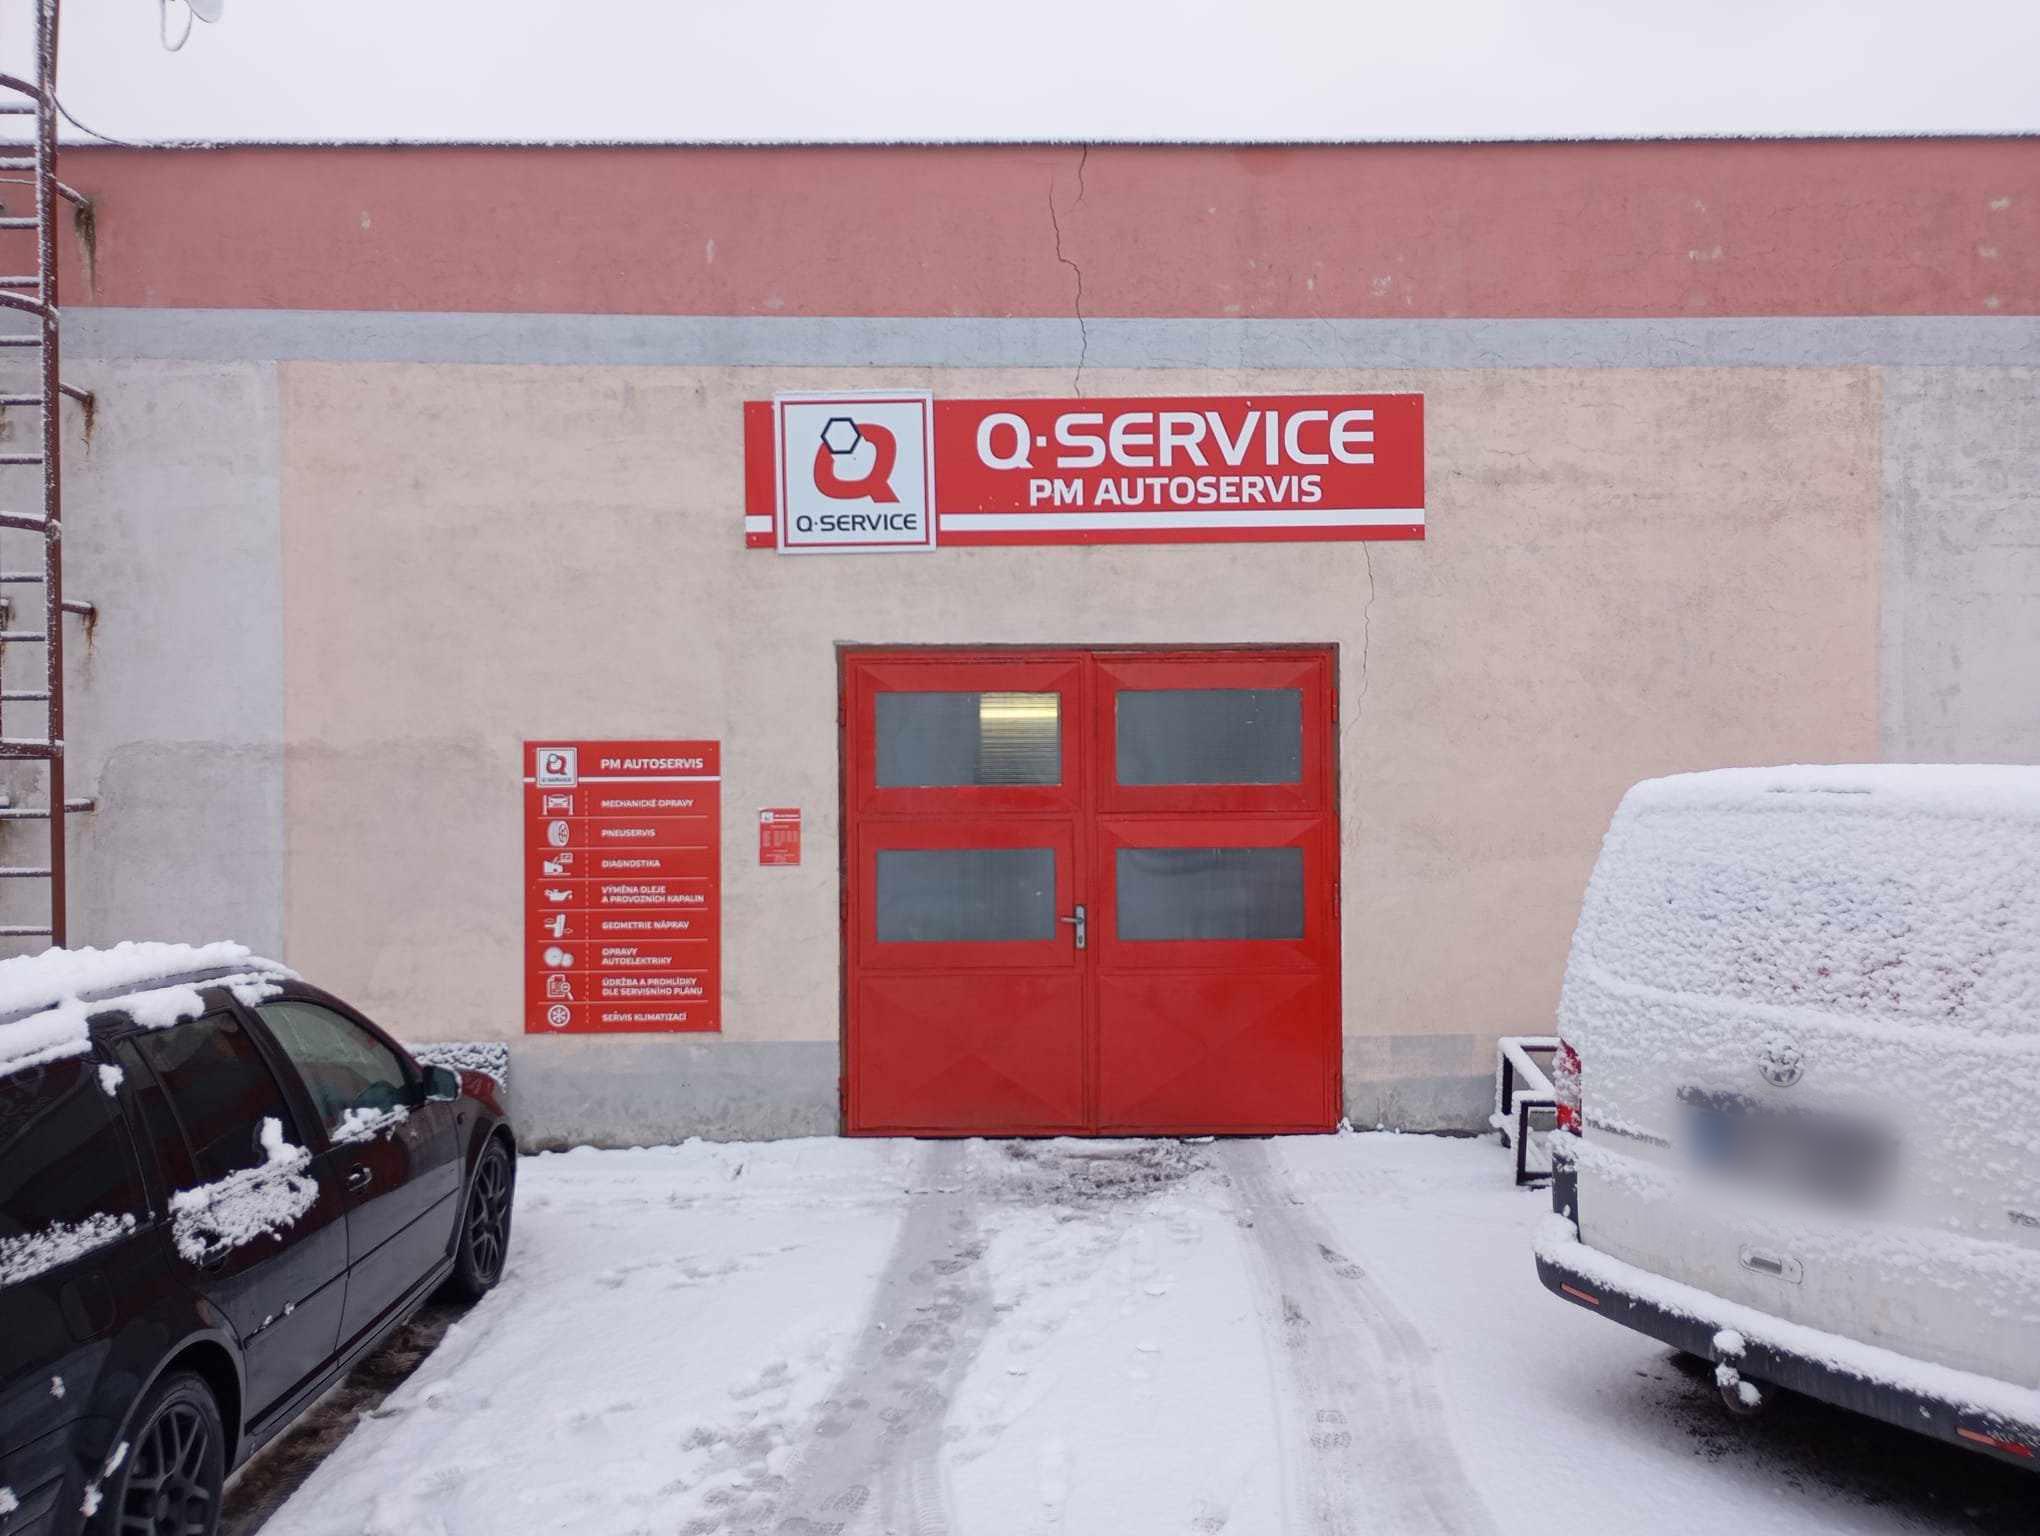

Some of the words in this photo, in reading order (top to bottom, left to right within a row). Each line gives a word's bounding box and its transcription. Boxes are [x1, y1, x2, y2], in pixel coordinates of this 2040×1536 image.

[1029, 478, 1084, 507] PM
[1094, 474, 1322, 506] AUTOSERVIS
[600, 758, 622, 770] PM
[622, 757, 704, 770] AUTOSERVIS
[658, 799, 694, 808] OPRAVY
[601, 828, 656, 838] PNEUSERVIS
[601, 859, 661, 868] DIAGNOSTIKA
[640, 885, 667, 894] OLEJE
[601, 895, 609, 904] A
[667, 894, 704, 903] KAPALIN
[601, 920, 652, 930] GEOMETRIE
[601, 947, 638, 956] OPRAVY
[601, 956, 672, 966] AUTOELEKTRIKY
[639, 978, 647, 987] A
[602, 987, 619, 997] DLE
[601, 1012, 633, 1022] SERVIS
